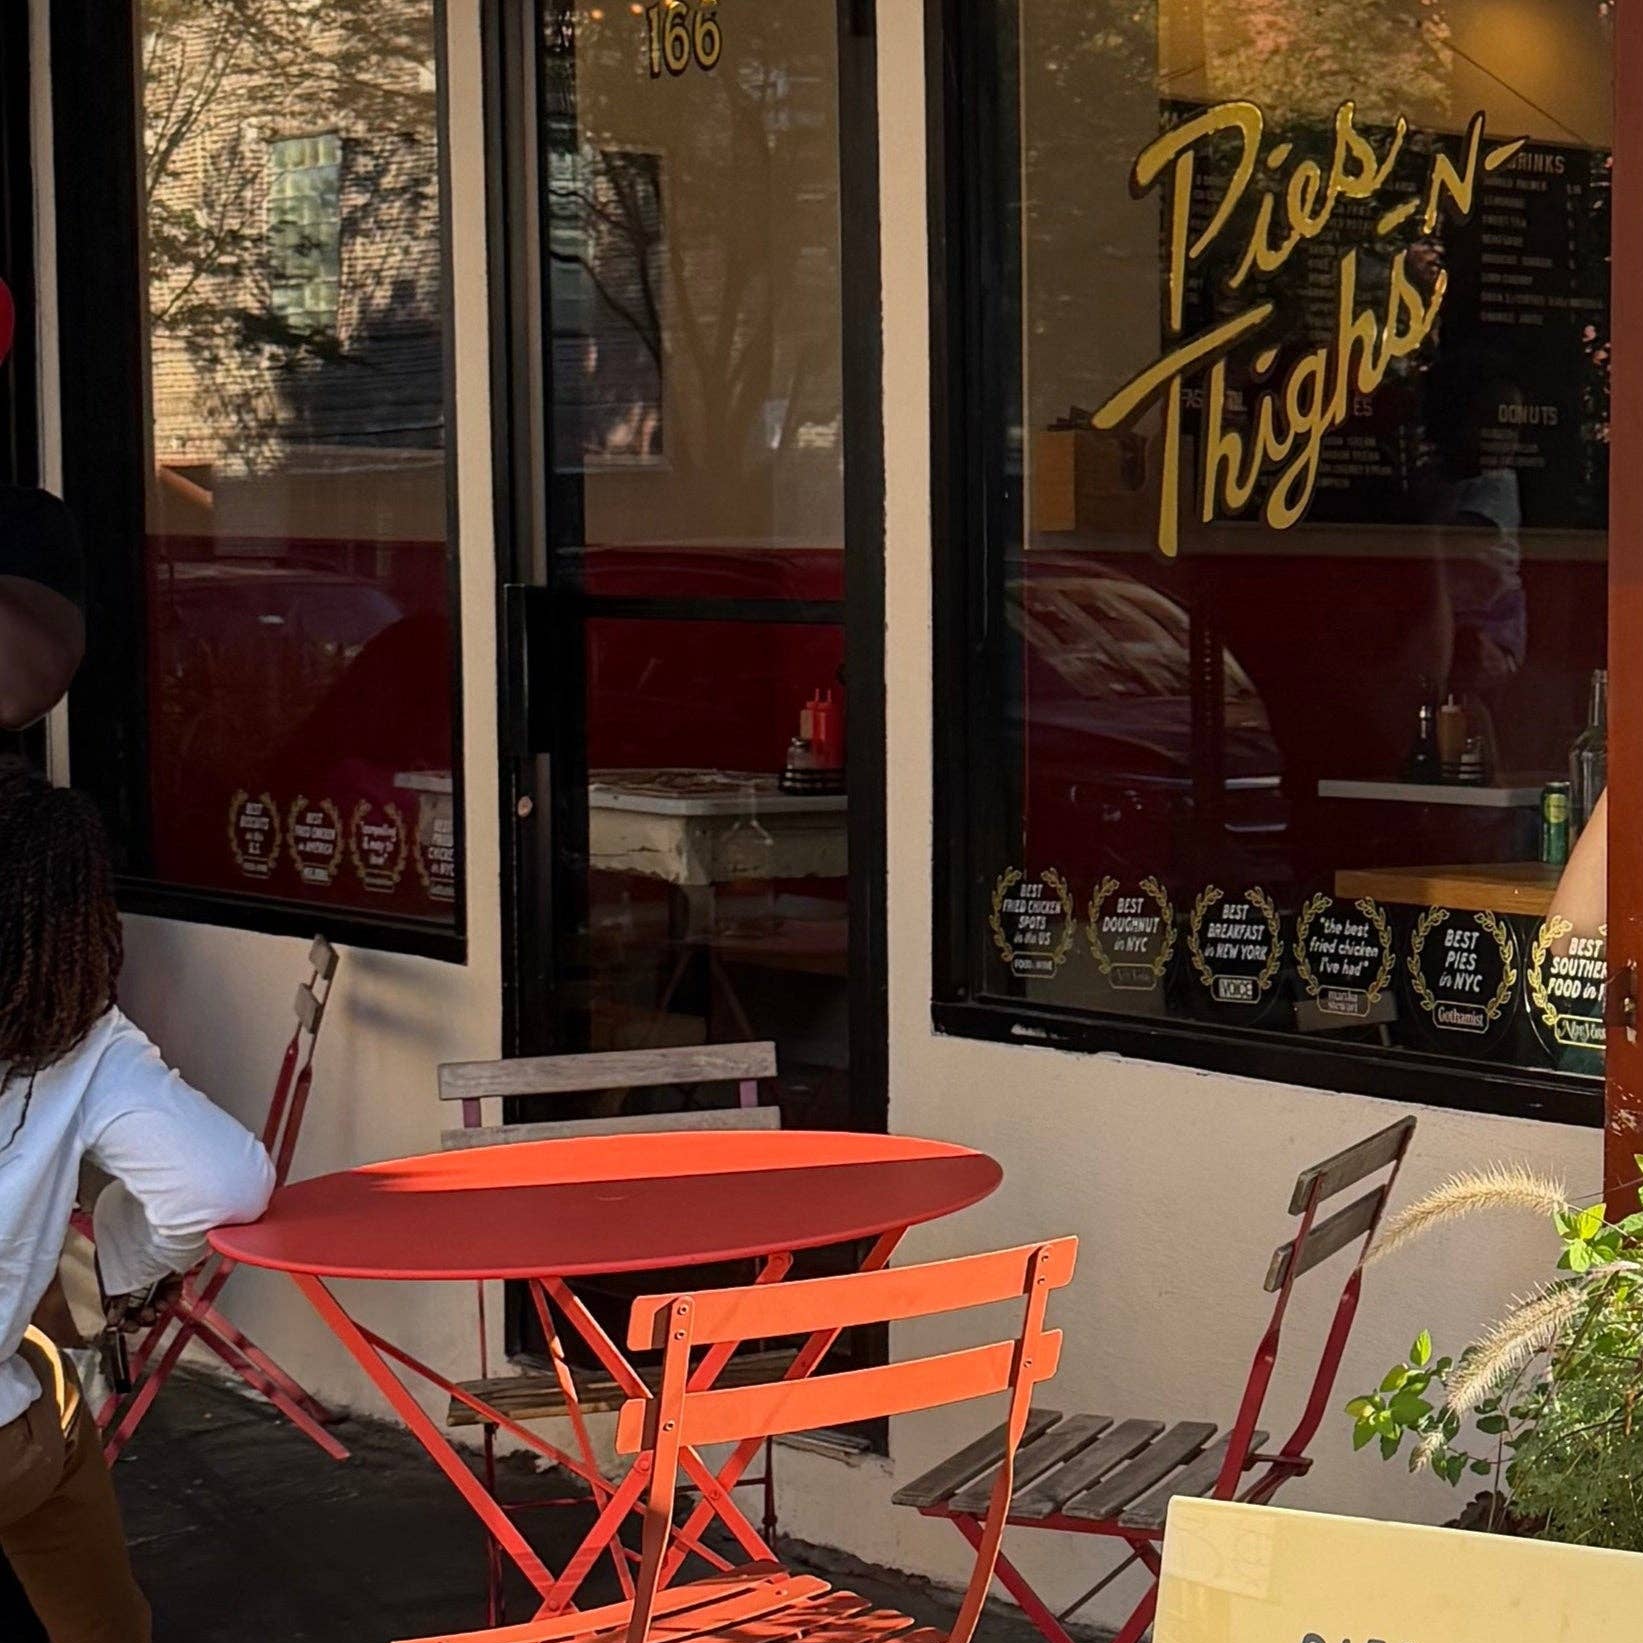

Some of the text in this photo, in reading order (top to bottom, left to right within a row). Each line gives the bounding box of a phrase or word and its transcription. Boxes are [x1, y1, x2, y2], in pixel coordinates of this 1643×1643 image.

[647, 0, 721, 78] 166
[1135, 101, 1407, 333] Pies
[1091, 249, 1449, 558] Thighs
[1020, 884, 1043, 898] BEST
[1027, 901, 1061, 915] CHICKEN
[1116, 898, 1145, 914] BEST
[1222, 904, 1250, 920] BEST
[1018, 916, 1047, 930] SPOTS
[1101, 916, 1160, 934] DOUGHNUT
[1207, 923, 1266, 940] BREAKFAST
[1344, 920, 1370, 938] best
[1126, 937, 1149, 952] NYC
[1310, 936, 1379, 958] fried chicken
[1444, 928, 1480, 950] BEST
[1568, 937, 1604, 958] BEST
[1216, 943, 1240, 959] NEW
[1241, 944, 1269, 961] YORK
[1445, 950, 1478, 971] PIES
[1320, 957, 1340, 974] I've
[1438, 971, 1483, 993] in NYC
[1547, 977, 1581, 999] FOOD
[1582, 982, 1597, 999] in
[1437, 1006, 1484, 1027] Gothamist
